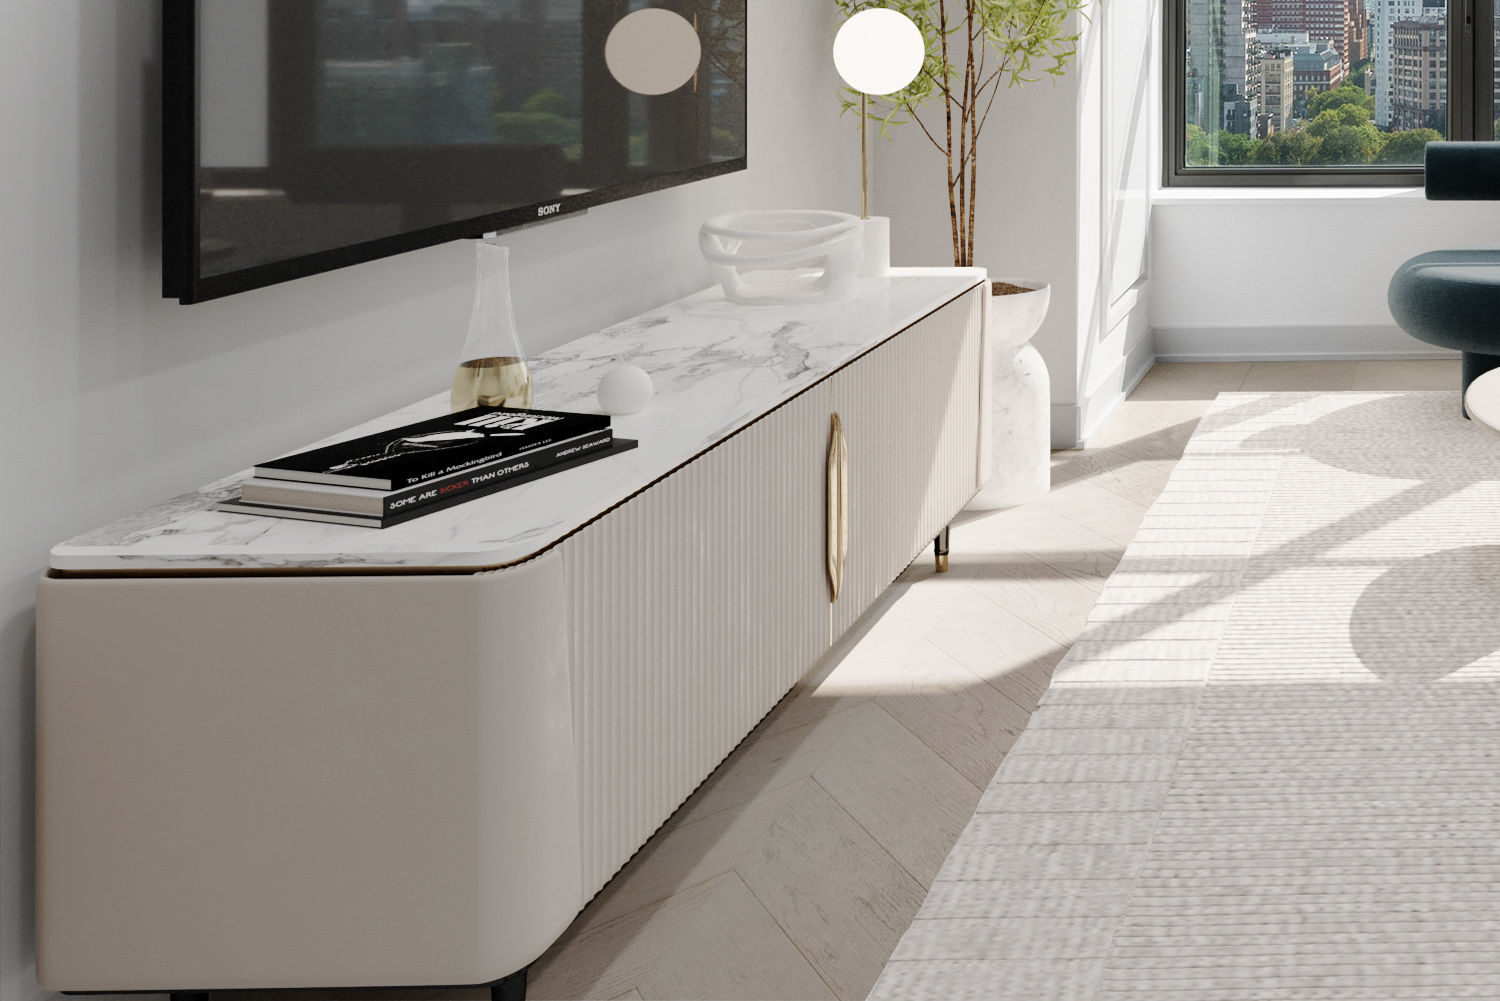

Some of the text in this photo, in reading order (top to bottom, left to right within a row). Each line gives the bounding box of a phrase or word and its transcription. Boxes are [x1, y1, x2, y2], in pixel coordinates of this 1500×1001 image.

[537, 203, 561, 216] SONY
[555, 436, 611, 458] ANDREW SEAWARD
[421, 471, 436, 480] Kill
[446, 451, 503, 473] Mockingbird
[389, 461, 530, 510] SOME ARE SICKER THAN OTHERS
